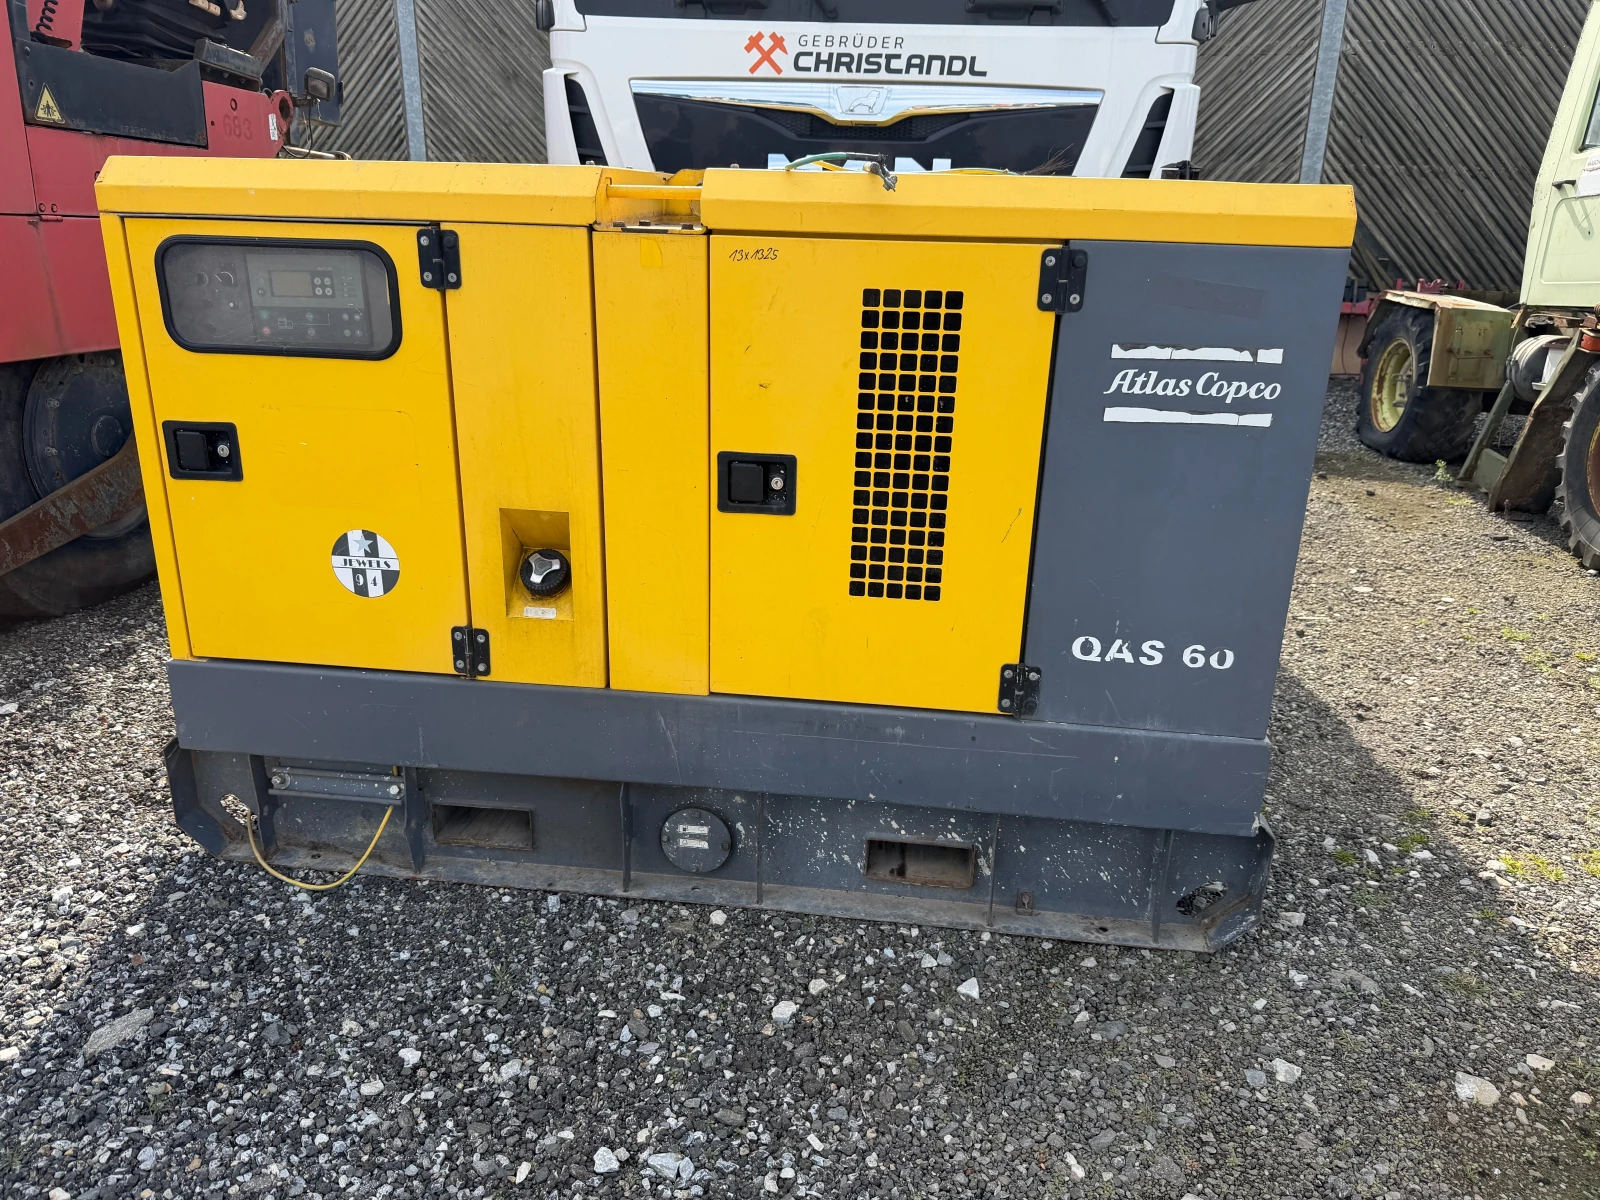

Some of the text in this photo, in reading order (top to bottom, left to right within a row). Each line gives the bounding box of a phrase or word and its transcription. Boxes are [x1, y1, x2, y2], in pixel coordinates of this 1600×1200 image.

[798, 33, 905, 50] GEBRÜDER
[793, 51, 988, 77] CHRISTANDL
[223, 113, 254, 141] 683
[1103, 368, 1282, 404] Atlas Copco
[341, 558, 391, 569] JEWELS
[1071, 635, 1235, 670] QAS 60
